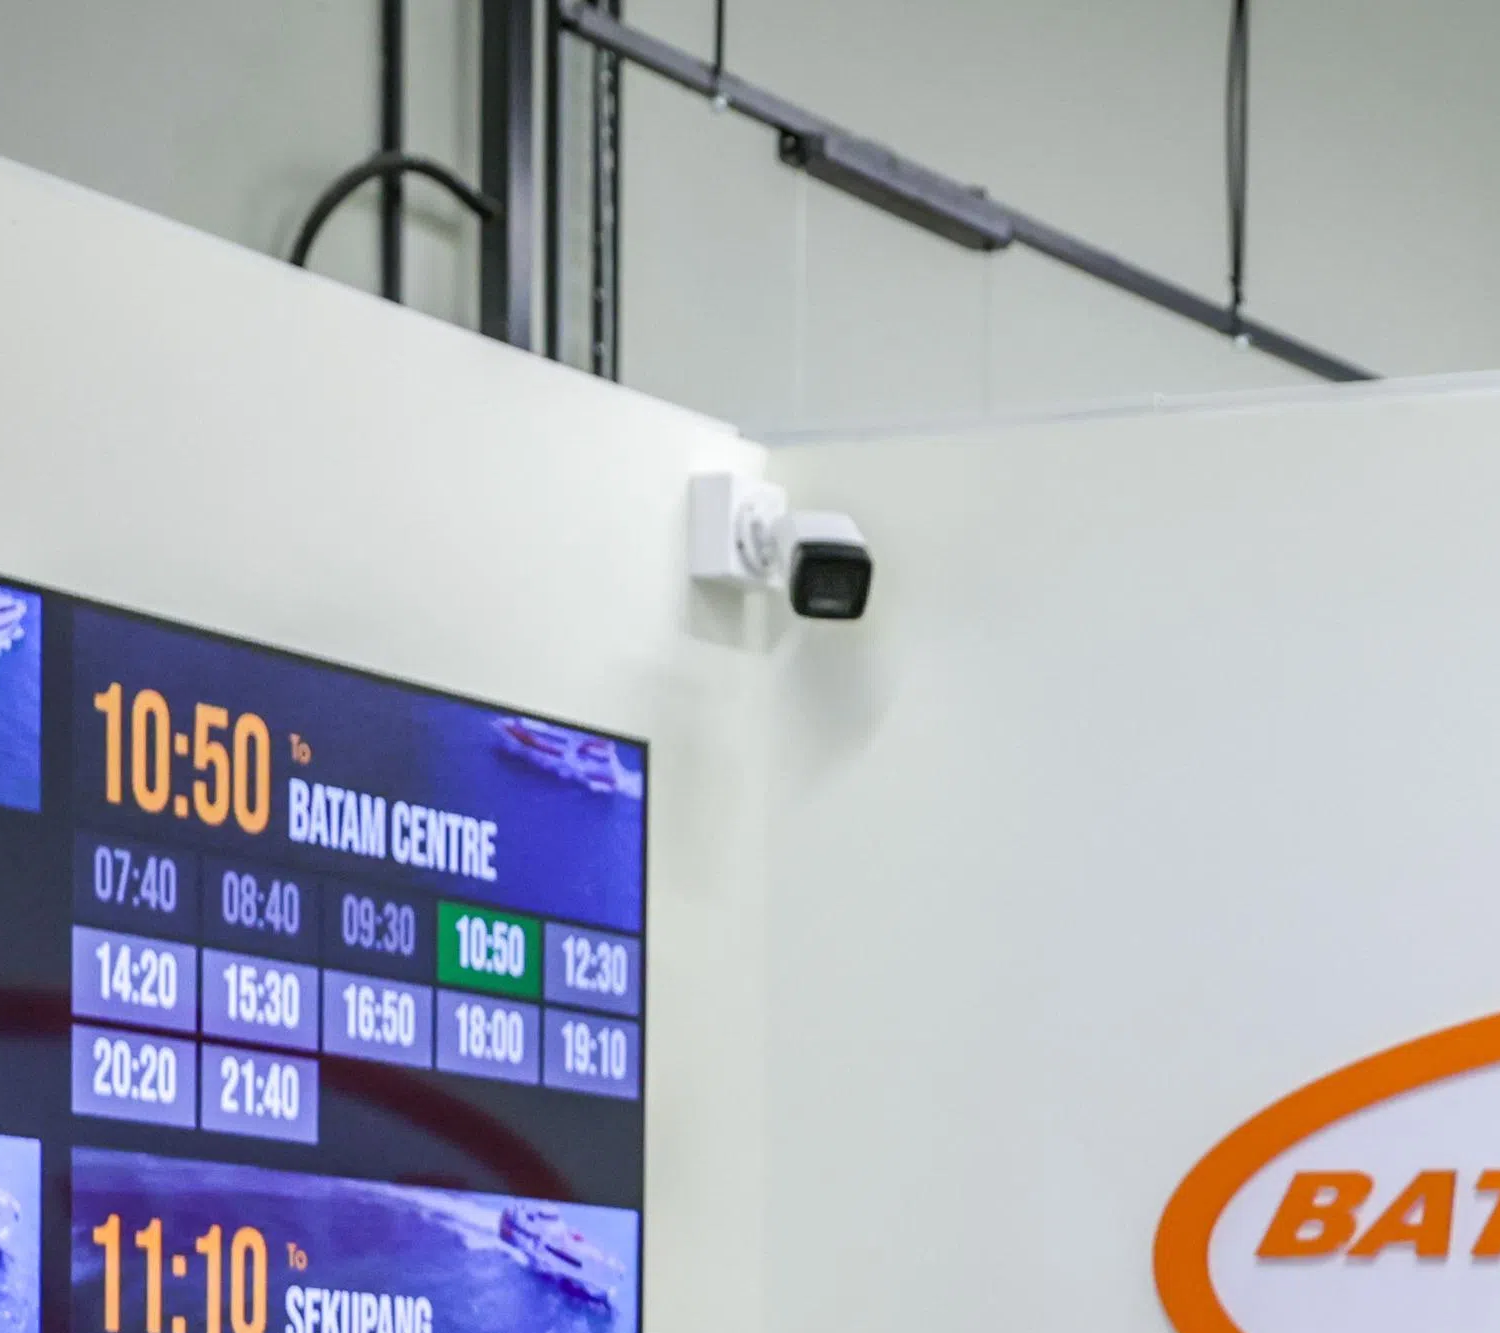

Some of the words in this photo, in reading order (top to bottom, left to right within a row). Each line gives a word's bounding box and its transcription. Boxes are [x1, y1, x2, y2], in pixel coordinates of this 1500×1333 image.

[94, 683, 271, 833] 10:50
[290, 733, 313, 765] To
[289, 778, 386, 858] BATAM
[392, 801, 497, 881] CENTRE
[95, 846, 176, 912] 07:40
[223, 871, 299, 934] 08:40
[343, 894, 415, 956] 09:30
[455, 914, 524, 978] 10:50
[562, 935, 628, 996] 12:30
[96, 941, 177, 1009] 14:20
[223, 963, 300, 1029] 15:30
[343, 983, 415, 1047] 16:50
[455, 1002, 524, 1064] 18:00
[561, 1021, 626, 1080] 19:10
[93, 1037, 177, 1105] 20:20
[220, 1056, 299, 1121] 21:40
[287, 1242, 308, 1271] To
